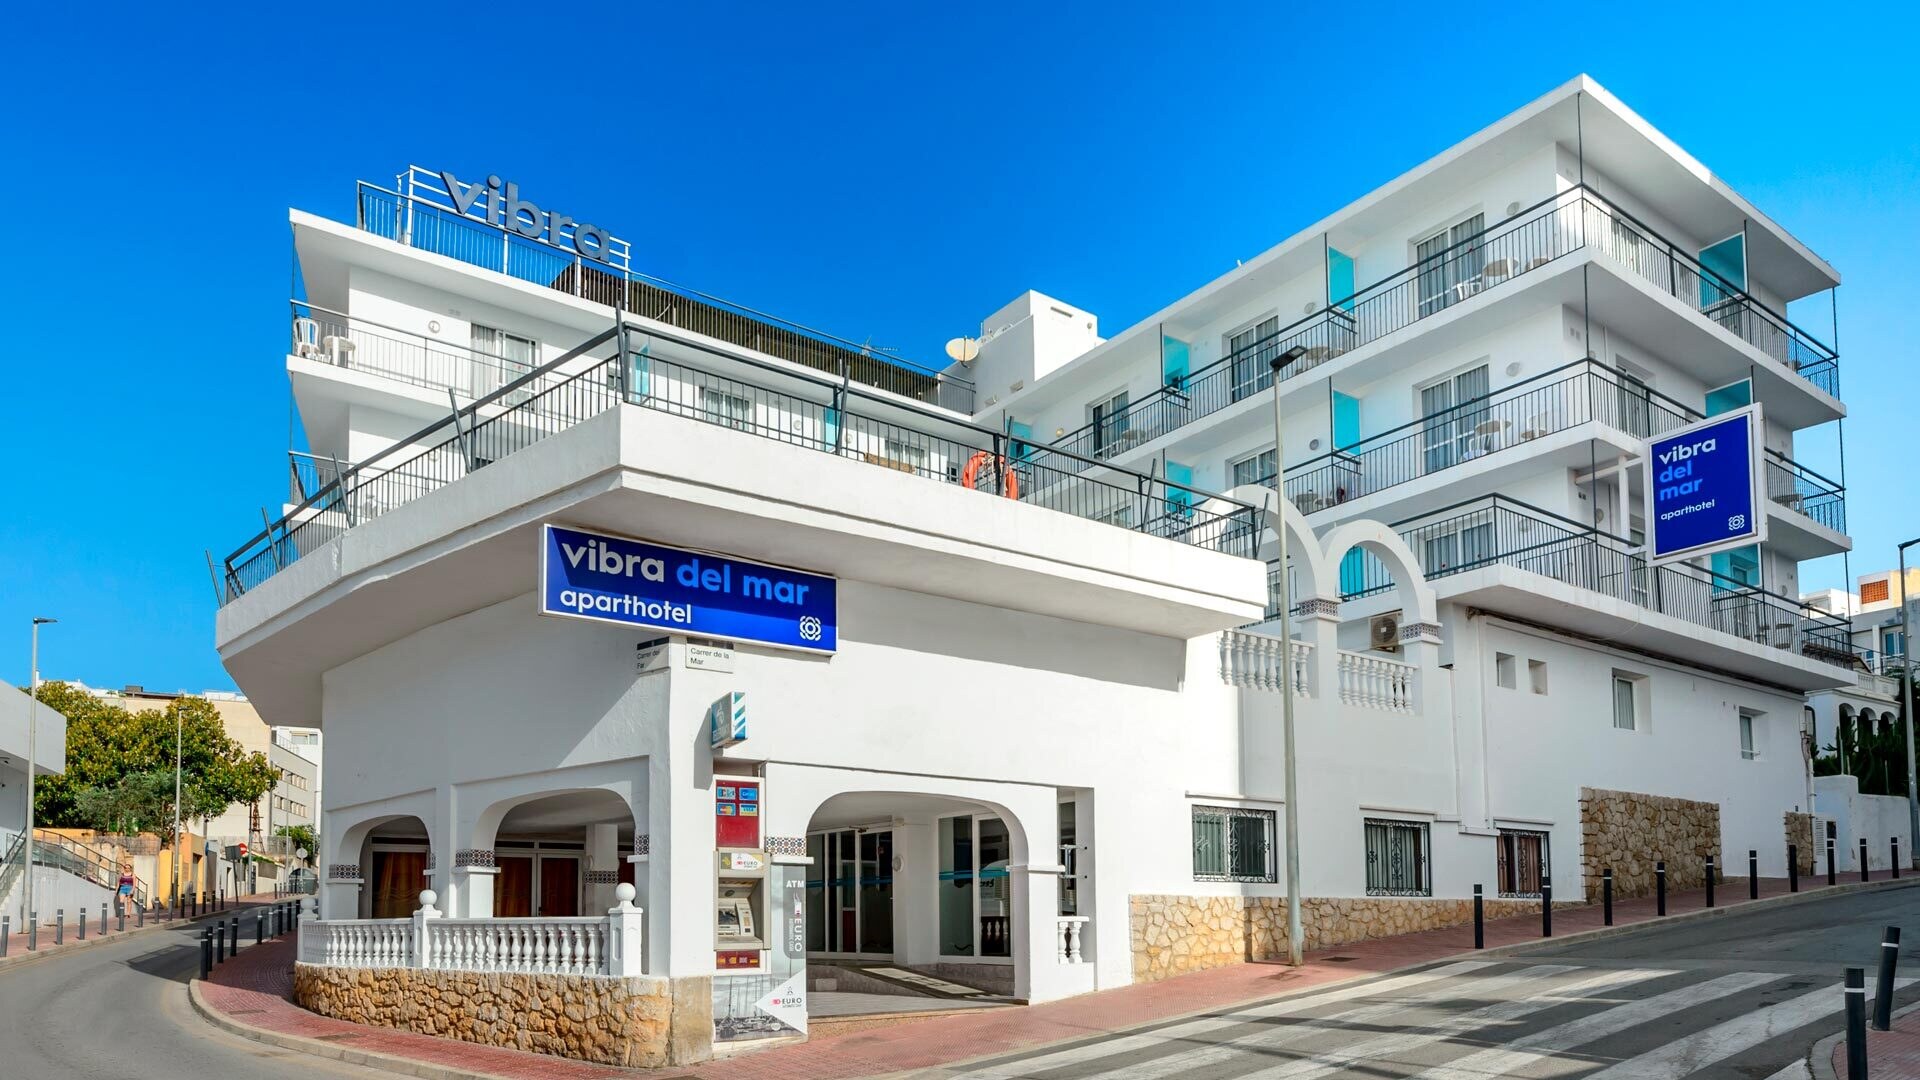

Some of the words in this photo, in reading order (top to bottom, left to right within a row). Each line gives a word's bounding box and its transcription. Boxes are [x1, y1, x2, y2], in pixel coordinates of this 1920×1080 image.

[440, 171, 610, 264] vibra
[1659, 438, 1716, 465] vibra
[1659, 460, 1693, 484] del
[1660, 478, 1703, 502] mar
[1660, 499, 1715, 521] aparthotel
[561, 539, 665, 583] vibra
[676, 558, 730, 593] del
[743, 576, 809, 606] mar
[559, 589, 692, 624] aparthotel
[690, 647, 712, 657] Carrer
[713, 650, 722, 658] de
[723, 651, 730, 659] la
[690, 657, 704, 665] Mar
[786, 880, 805, 888] ATM
[794, 918, 802, 952] EURO
[782, 997, 802, 1005] EURO
